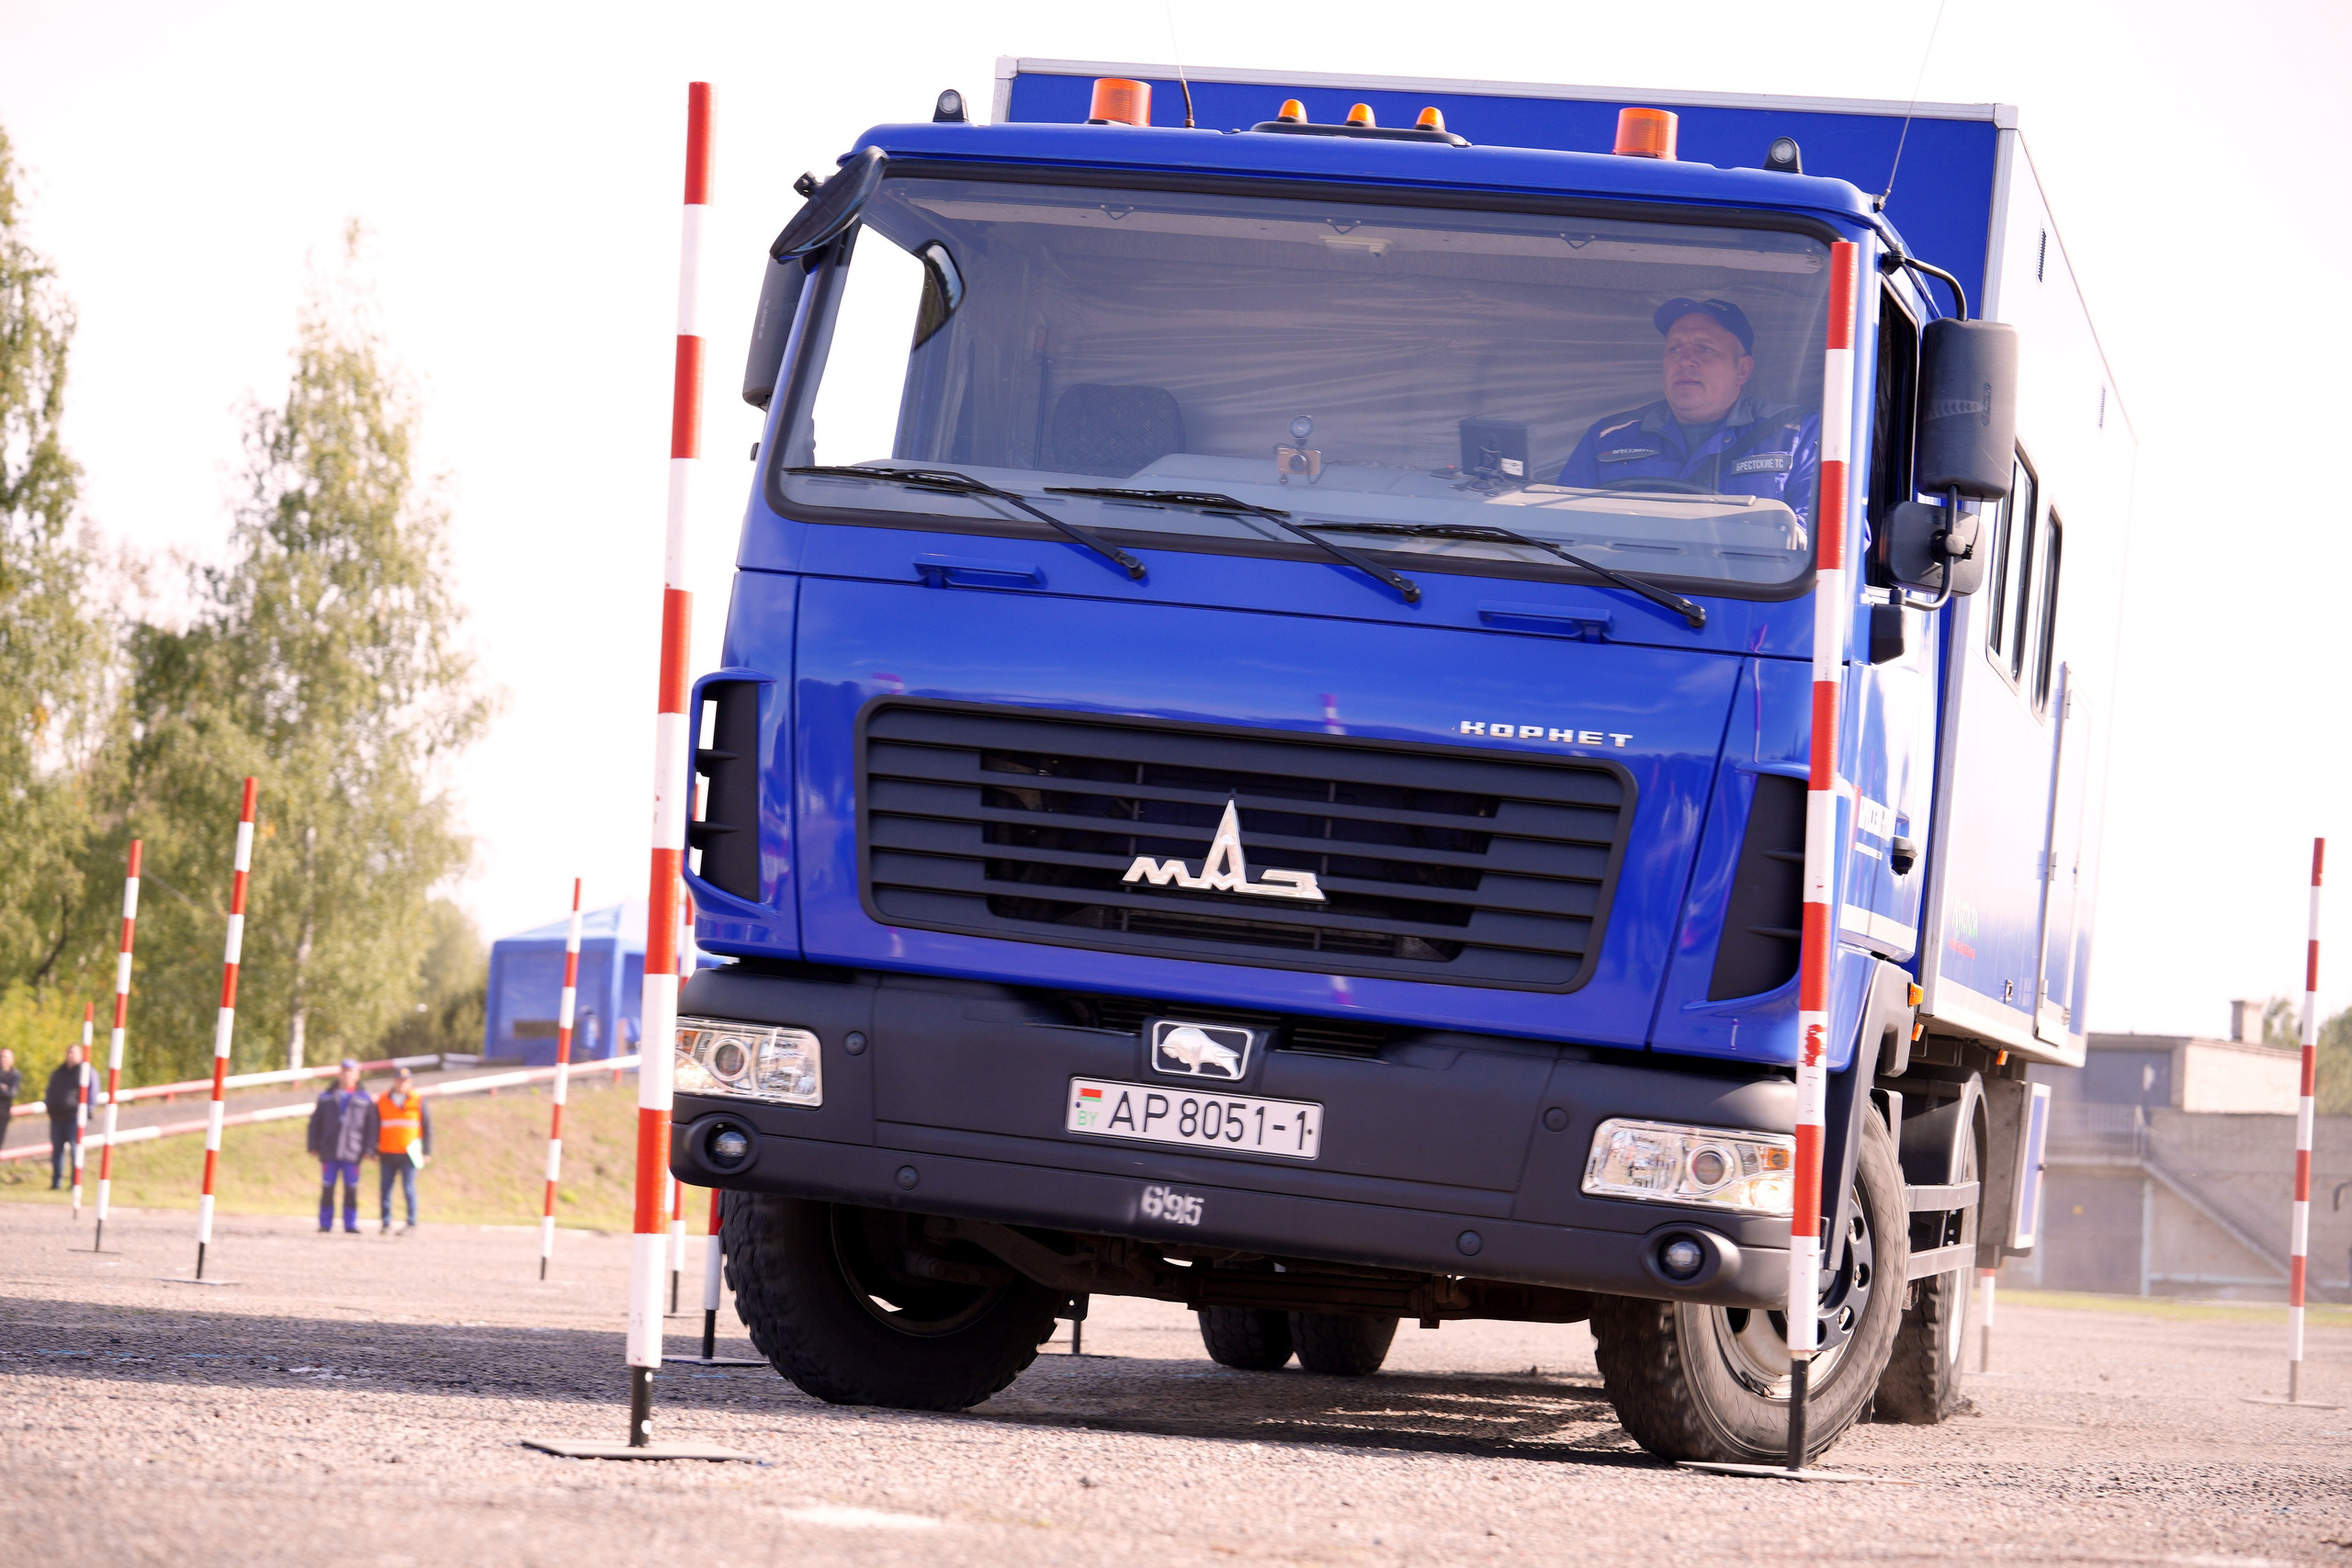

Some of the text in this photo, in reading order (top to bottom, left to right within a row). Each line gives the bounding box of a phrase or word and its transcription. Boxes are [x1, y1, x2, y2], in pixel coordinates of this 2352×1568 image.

[1460, 720, 1634, 748] КОРНЕТ
[1121, 798, 1327, 901] МАЗ
[1078, 1109, 1099, 1127] BY
[1141, 1185, 1204, 1226] 695
